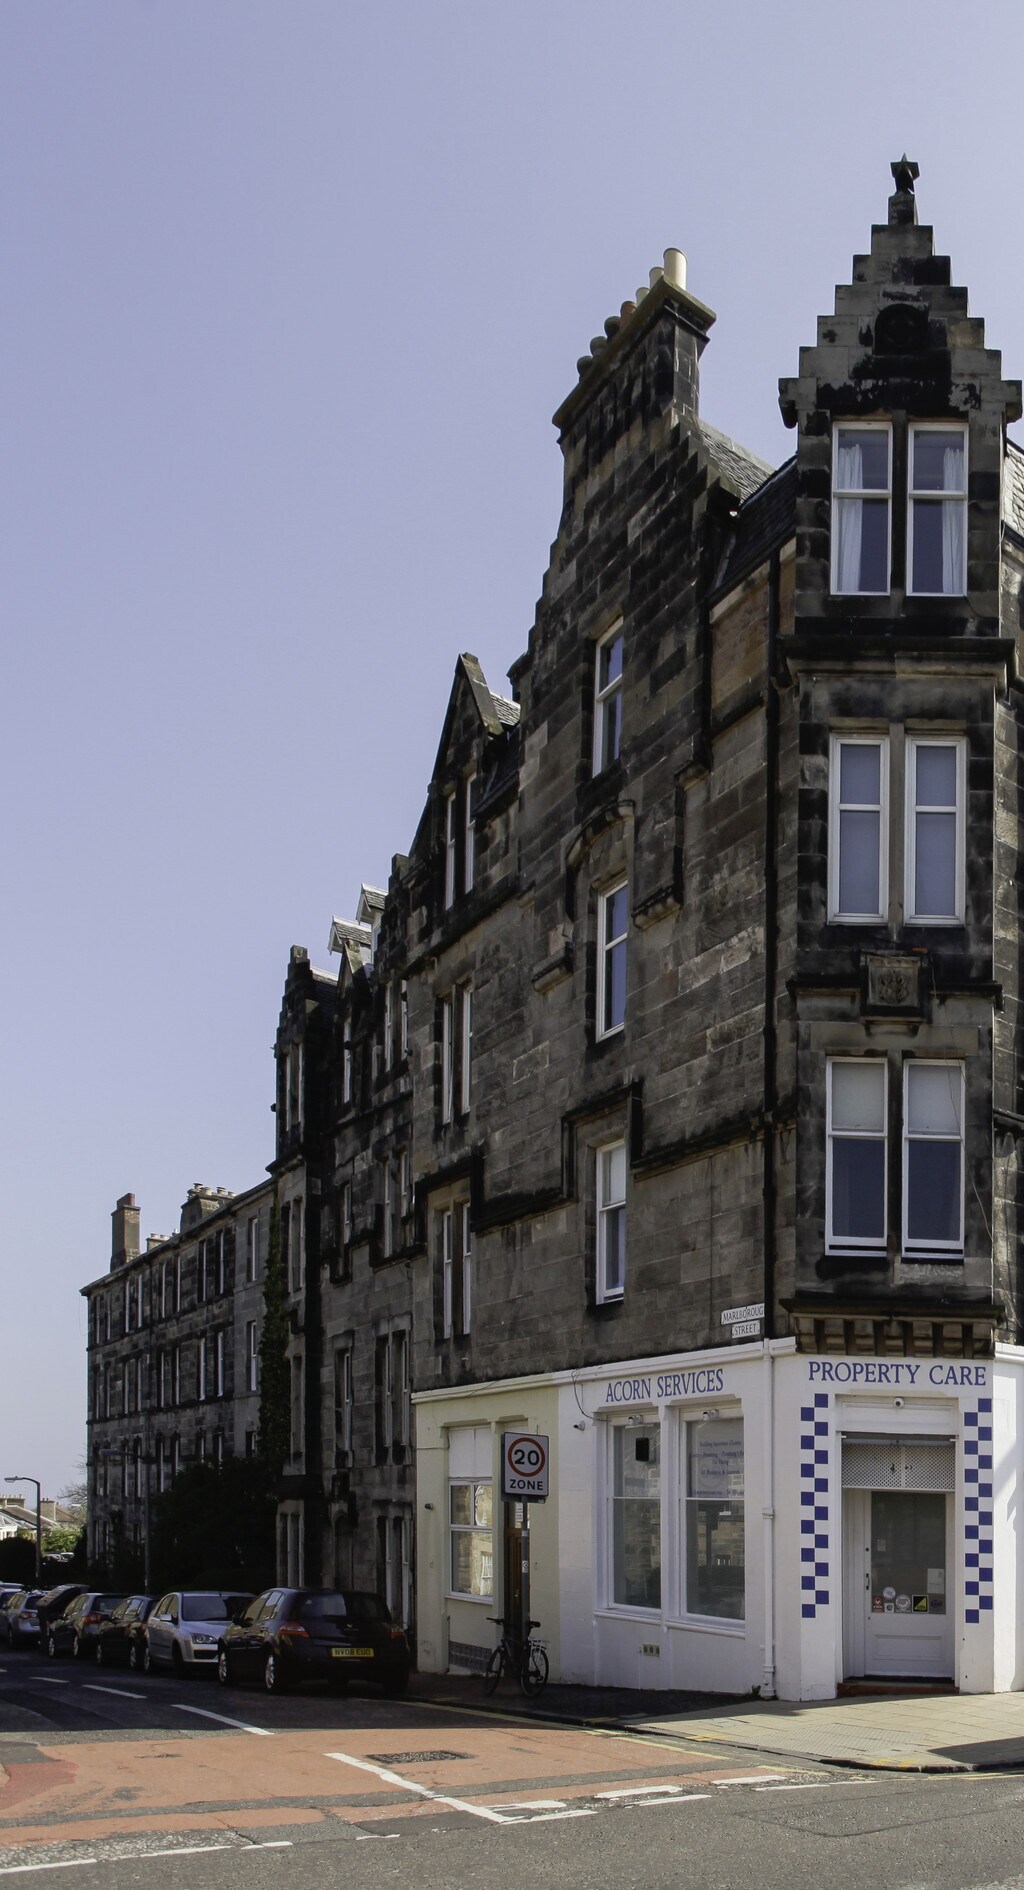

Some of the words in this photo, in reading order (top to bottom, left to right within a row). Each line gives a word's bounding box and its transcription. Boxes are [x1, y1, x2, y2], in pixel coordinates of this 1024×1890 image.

[722, 1306, 764, 1323] MARLBOROUG
[734, 1322, 757, 1336] STREET
[808, 1361, 921, 1384] PROPERTY
[928, 1364, 987, 1386] CARE
[605, 1377, 652, 1403] ACORN
[656, 1368, 724, 1398] SERVICES
[514, 1448, 540, 1466] 20
[509, 1479, 544, 1491] ZONE
